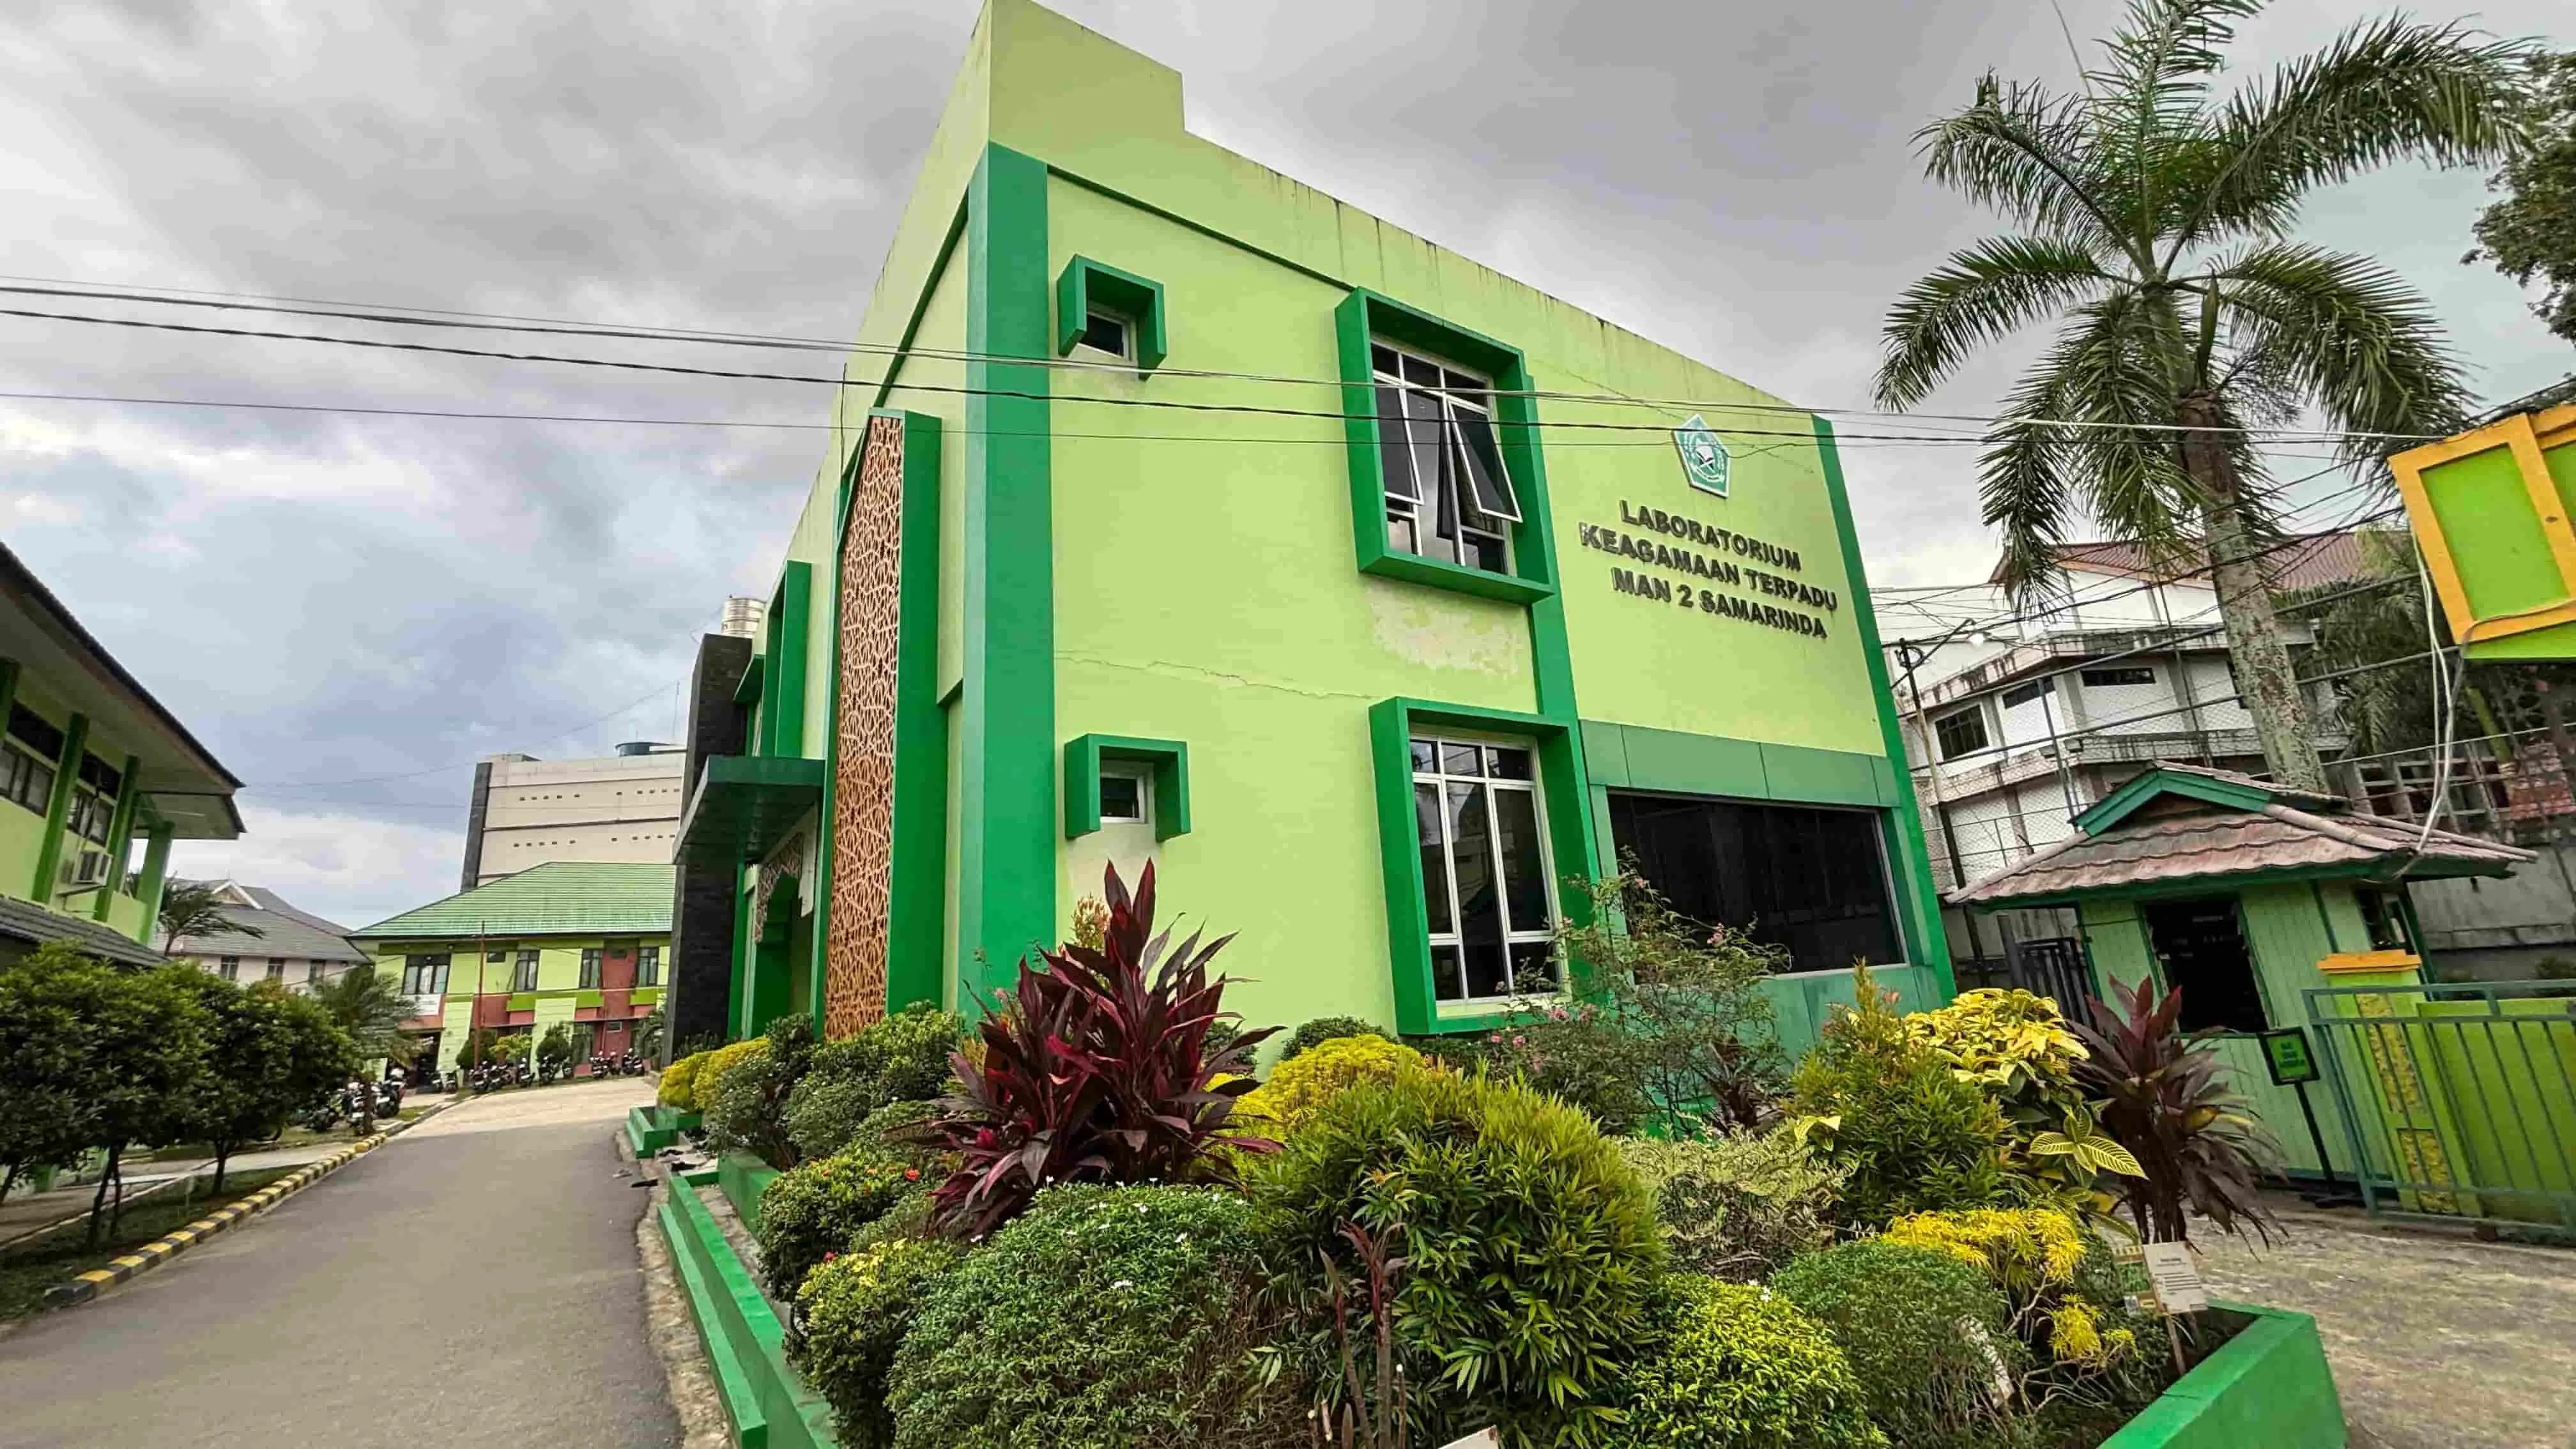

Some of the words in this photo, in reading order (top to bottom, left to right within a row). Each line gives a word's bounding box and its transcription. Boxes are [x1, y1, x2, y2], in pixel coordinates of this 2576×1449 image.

[1579, 521, 1741, 586] KEAGAMAAN
[1743, 567, 1838, 612] TERPADU
[1619, 500, 1802, 572] LABORATORIUM
[1611, 567, 1672, 603] MAN
[1676, 584, 1694, 608] 2
[1698, 590, 1828, 639] SAMARINDA
